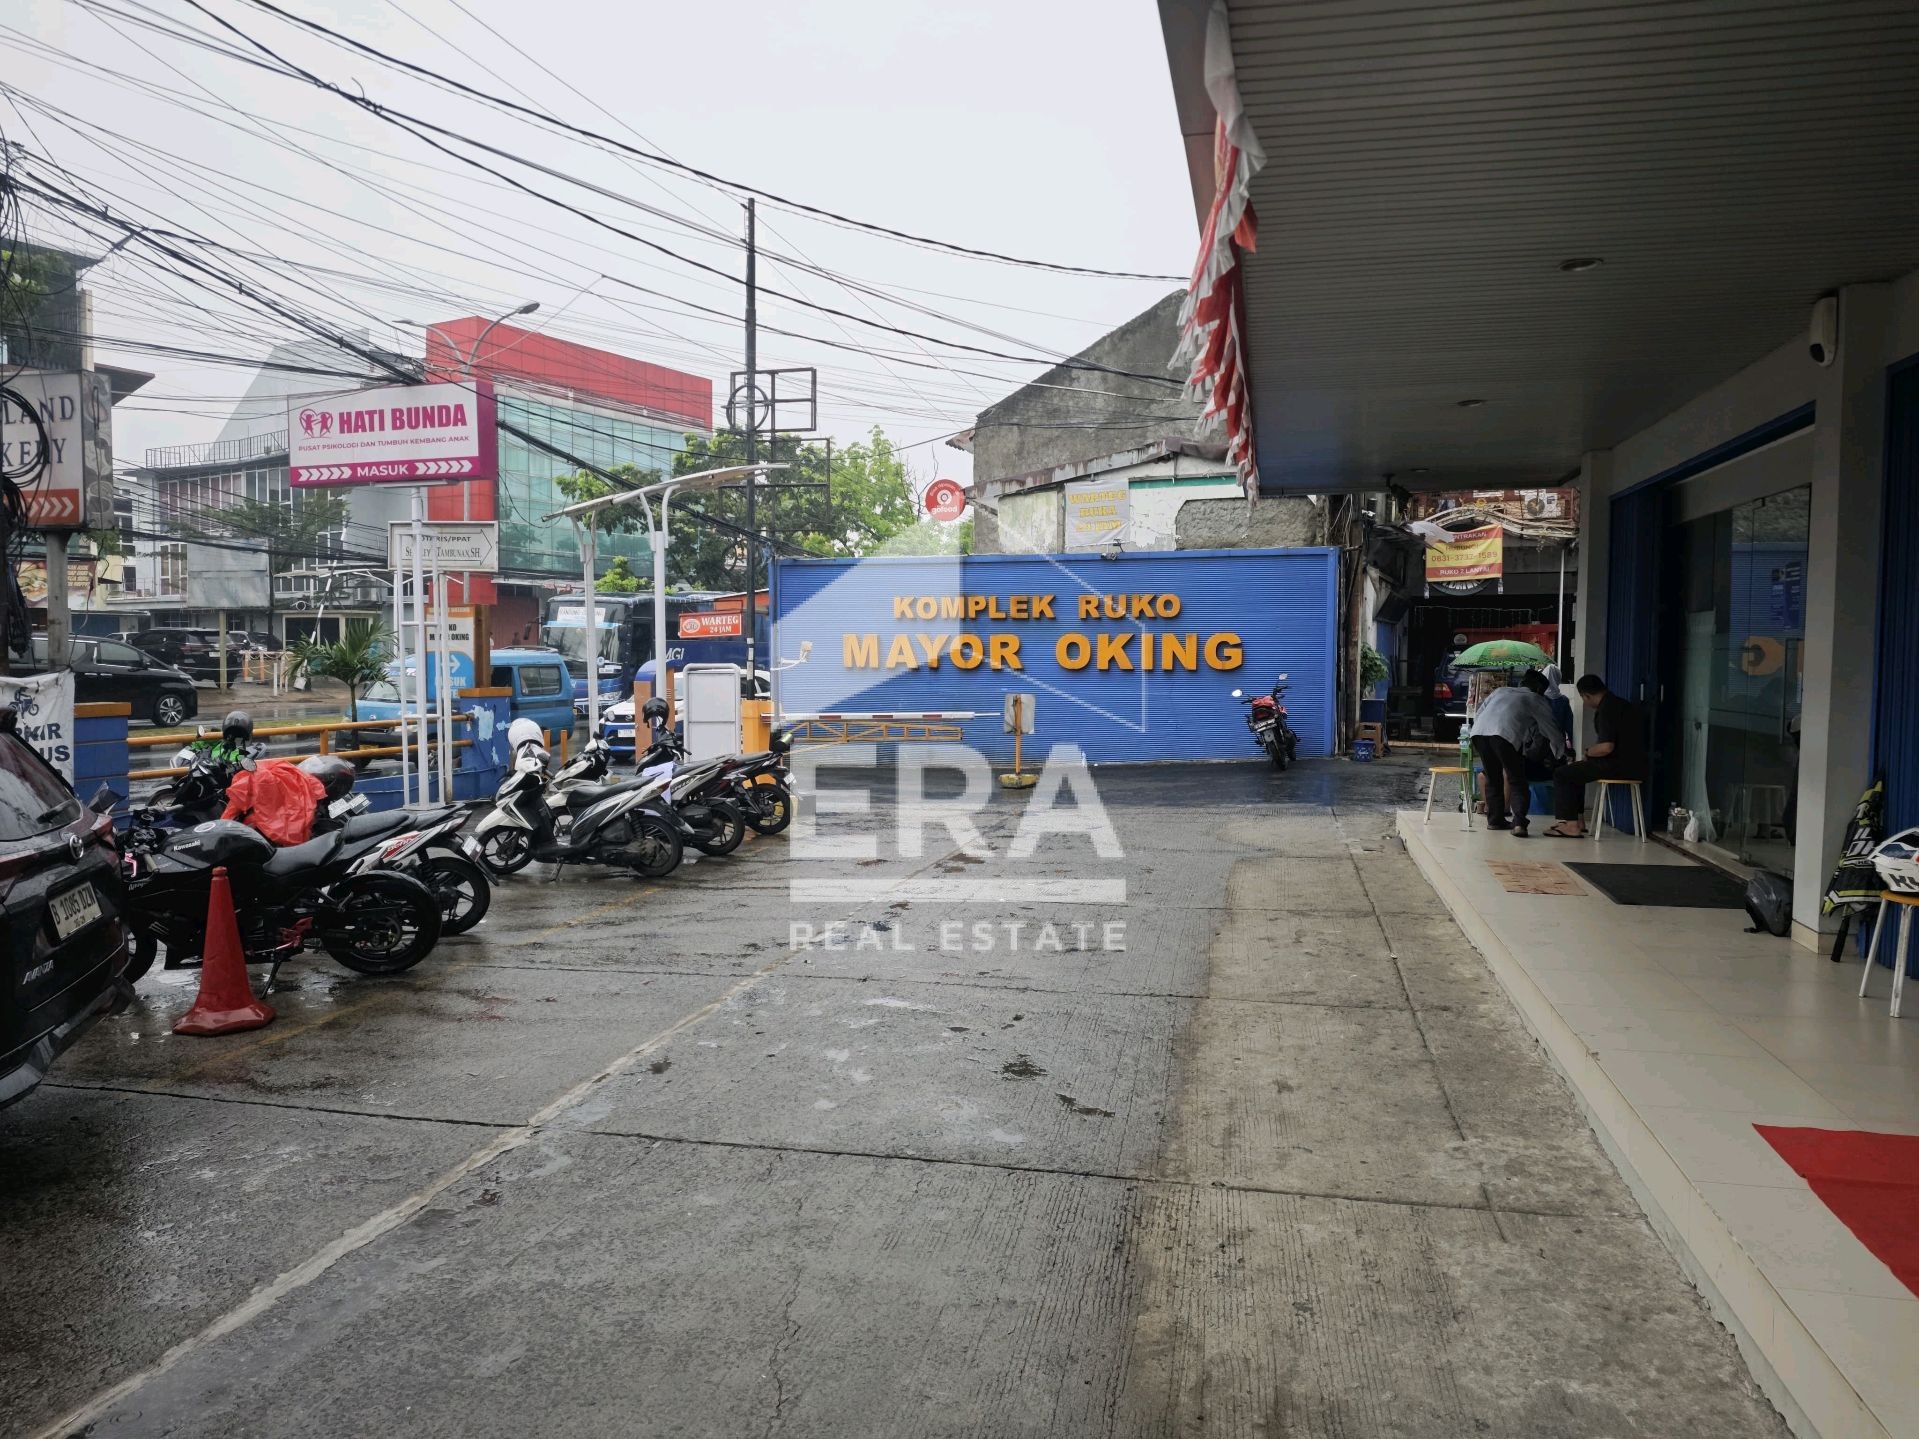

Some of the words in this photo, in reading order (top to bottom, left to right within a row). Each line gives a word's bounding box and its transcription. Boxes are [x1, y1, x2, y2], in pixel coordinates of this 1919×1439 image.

[338, 408, 385, 435] HATI
[391, 403, 468, 433] BUNDA
[298, 444, 321, 452] PUSAT
[322, 442, 359, 450] PSIKOLOGI
[360, 440, 376, 448] DAN
[378, 438, 409, 447] TUMBUH
[410, 436, 447, 445] KEMBANG
[357, 464, 409, 477] MASUK
[1069, 490, 1127, 505] WARTEG
[931, 505, 958, 515] gofood
[1079, 506, 1117, 518] BUKA
[1453, 532, 1487, 540] NTRAKAN
[893, 593, 1056, 621] KOMPLEK
[1078, 593, 1182, 620] RUKO
[701, 615, 739, 626] WARTEG
[719, 625, 732, 633] JAM
[843, 632, 1023, 671] MAYOR
[1055, 631, 1245, 672] OKING
[50, 903, 61, 925] B
